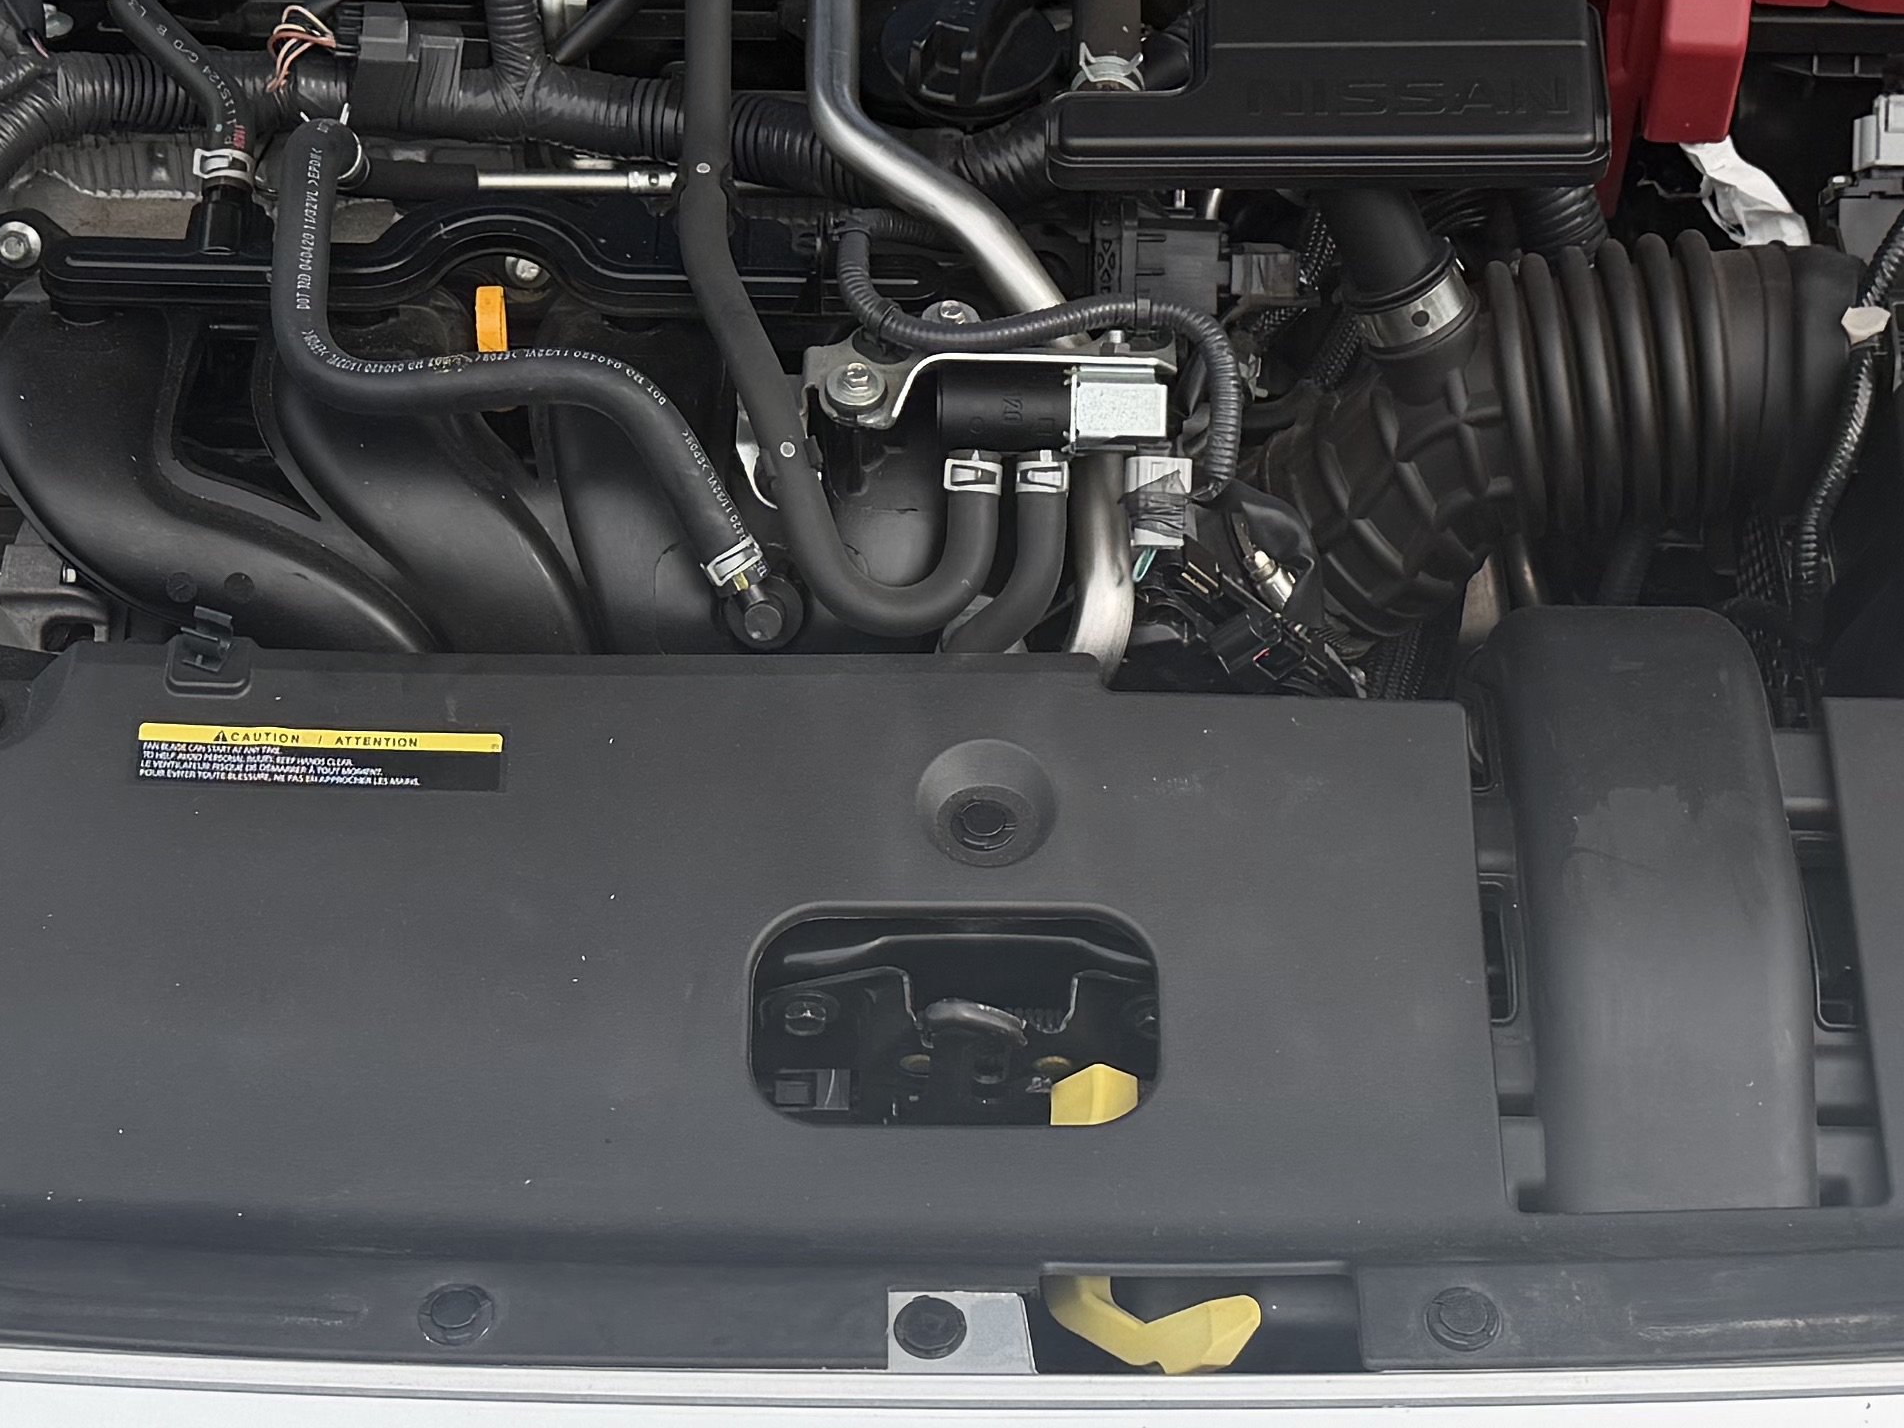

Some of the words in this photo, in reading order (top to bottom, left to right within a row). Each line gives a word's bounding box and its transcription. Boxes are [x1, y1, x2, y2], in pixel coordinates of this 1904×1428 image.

[1246, 76, 1570, 115] NISSAN
[299, 233, 315, 271] 040420
[296, 292, 311, 309] DOT
[646, 385, 667, 405] DOT
[231, 731, 300, 743] CAUTION
[335, 735, 418, 748] ATTENTION
